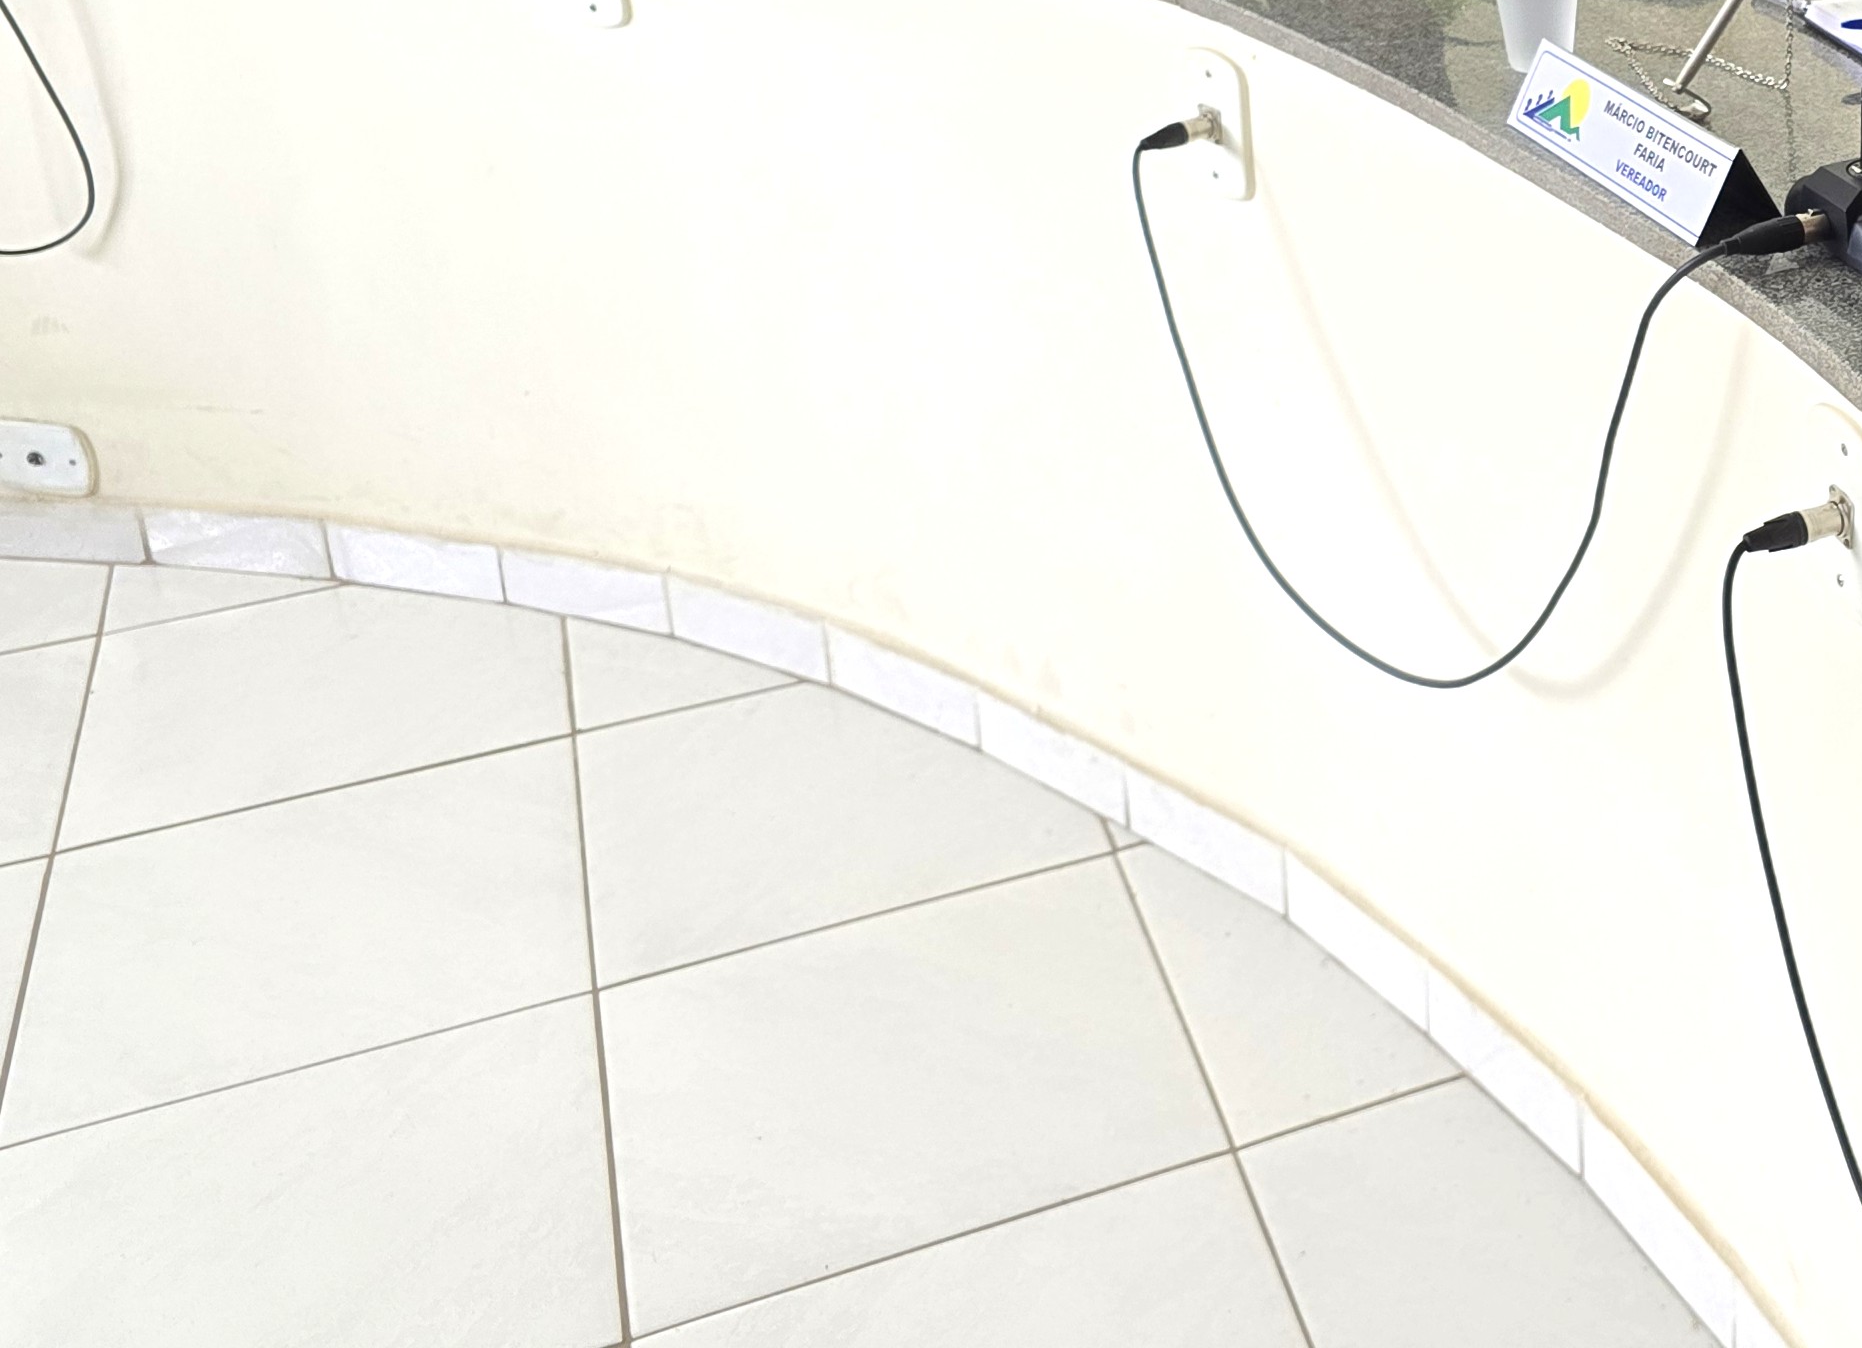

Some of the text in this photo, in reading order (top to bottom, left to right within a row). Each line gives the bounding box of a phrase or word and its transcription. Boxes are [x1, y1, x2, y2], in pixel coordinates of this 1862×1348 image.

[1604, 100, 1718, 178] MÁRCIO BITENCOURT
[1633, 143, 1666, 173] FARIA
[1615, 159, 1668, 202] VEREADOR
